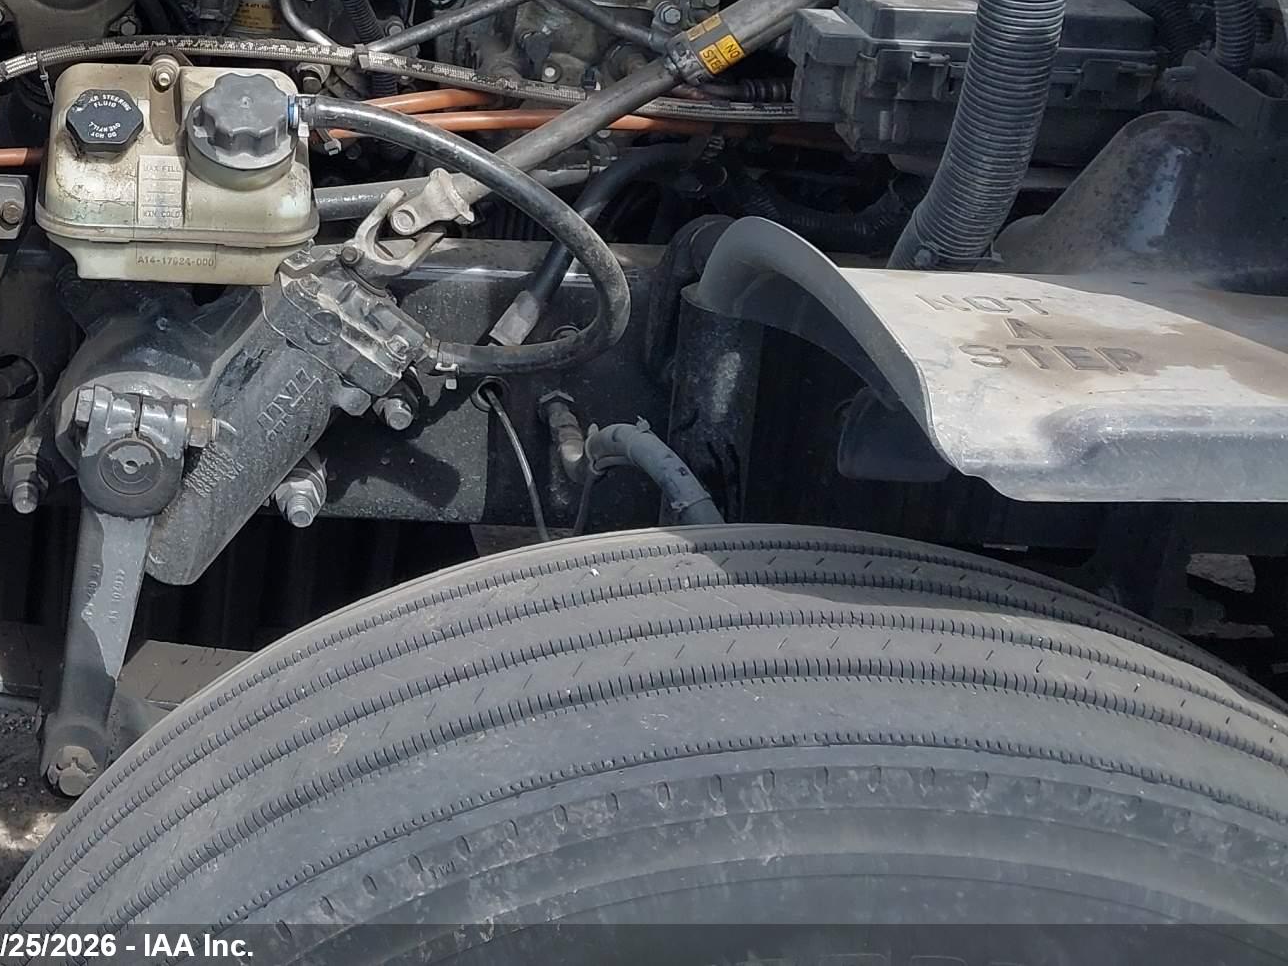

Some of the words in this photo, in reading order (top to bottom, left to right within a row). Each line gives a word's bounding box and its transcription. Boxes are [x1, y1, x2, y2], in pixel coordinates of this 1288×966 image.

[726, 42, 740, 59] NO
[102, 94, 132, 112] STEERING
[915, 293, 1049, 315] NOT
[1002, 317, 1053, 340] A
[958, 344, 1143, 372] STEP
